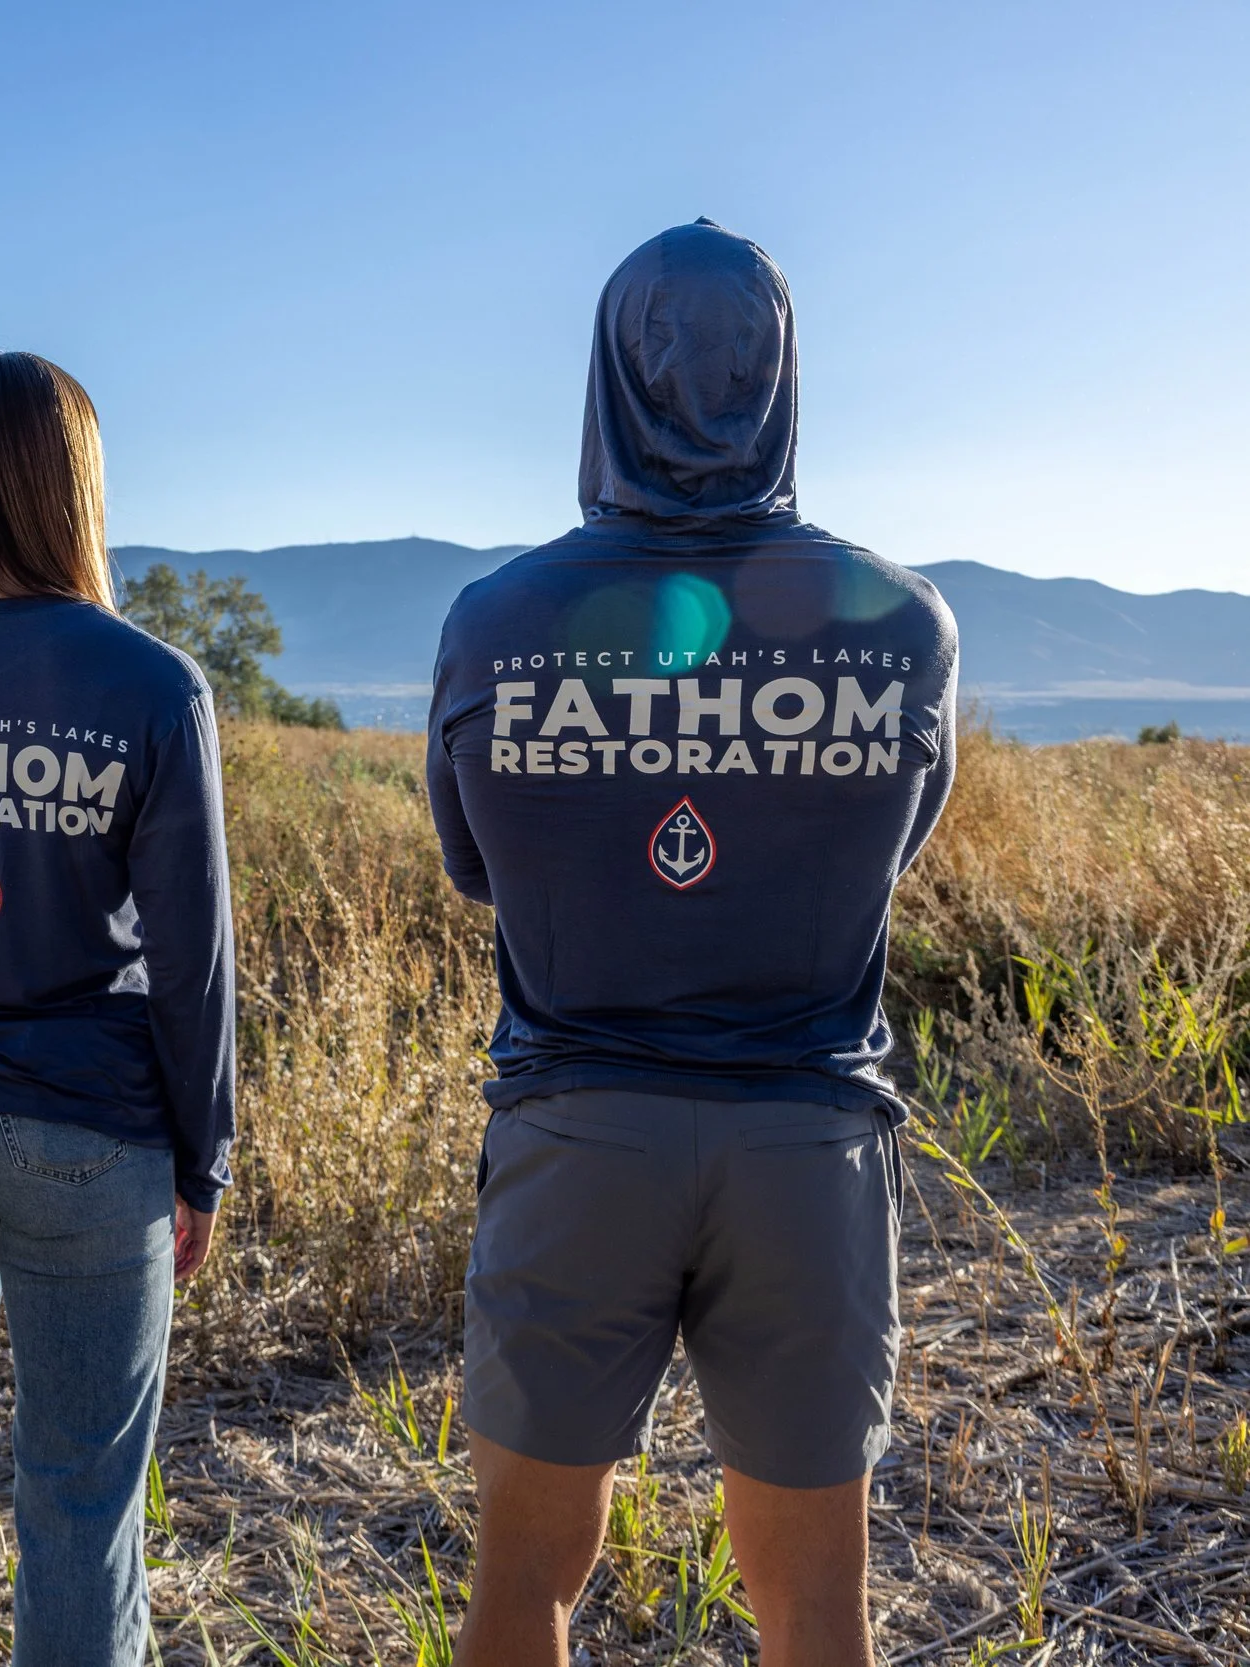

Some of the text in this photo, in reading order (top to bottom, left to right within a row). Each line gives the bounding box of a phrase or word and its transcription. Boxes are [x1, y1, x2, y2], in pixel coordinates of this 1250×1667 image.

[493, 648, 912, 675] PROTECT UTAH'S LAKES
[492, 676, 906, 738] FATHOM
[51, 723, 128, 753] LAKES
[490, 739, 901, 776] RESTORATION
